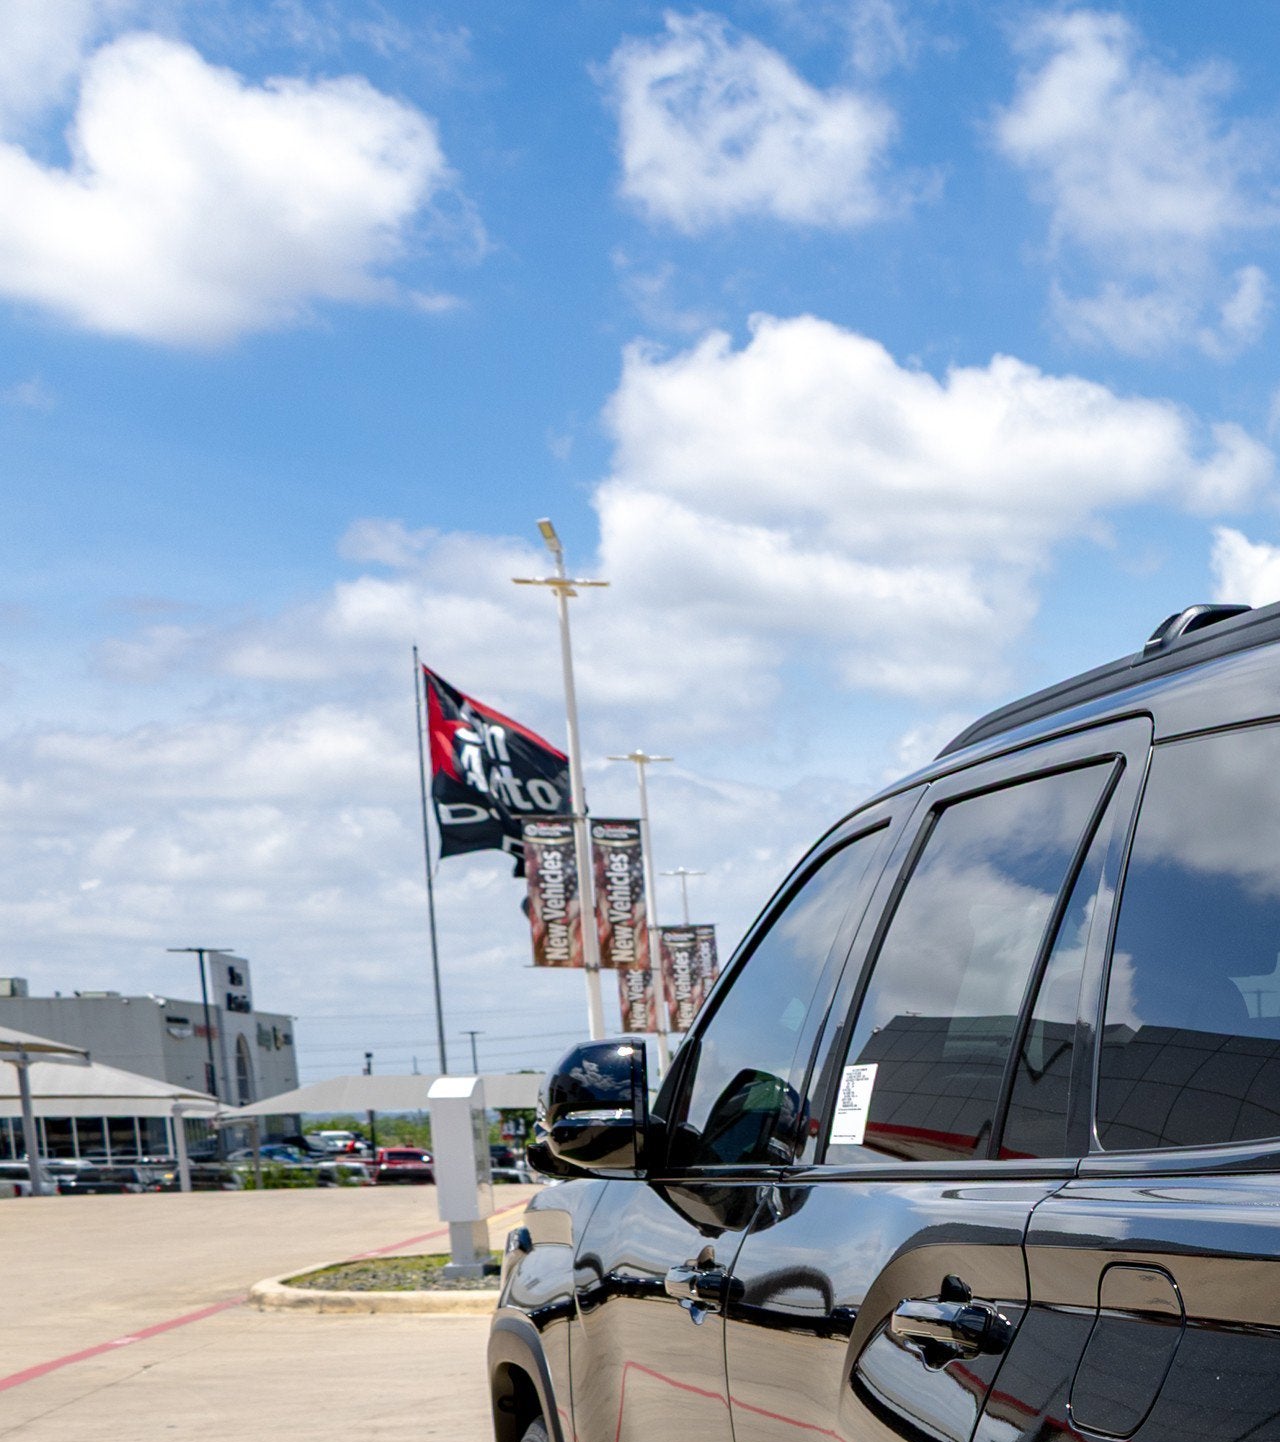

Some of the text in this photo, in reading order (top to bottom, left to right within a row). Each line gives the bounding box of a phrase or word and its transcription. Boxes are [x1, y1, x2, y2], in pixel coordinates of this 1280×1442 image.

[538, 851, 567, 921] Vehicles
[606, 853, 632, 922] Vehicles
[545, 924, 569, 960] New
[611, 925, 635, 962] New
